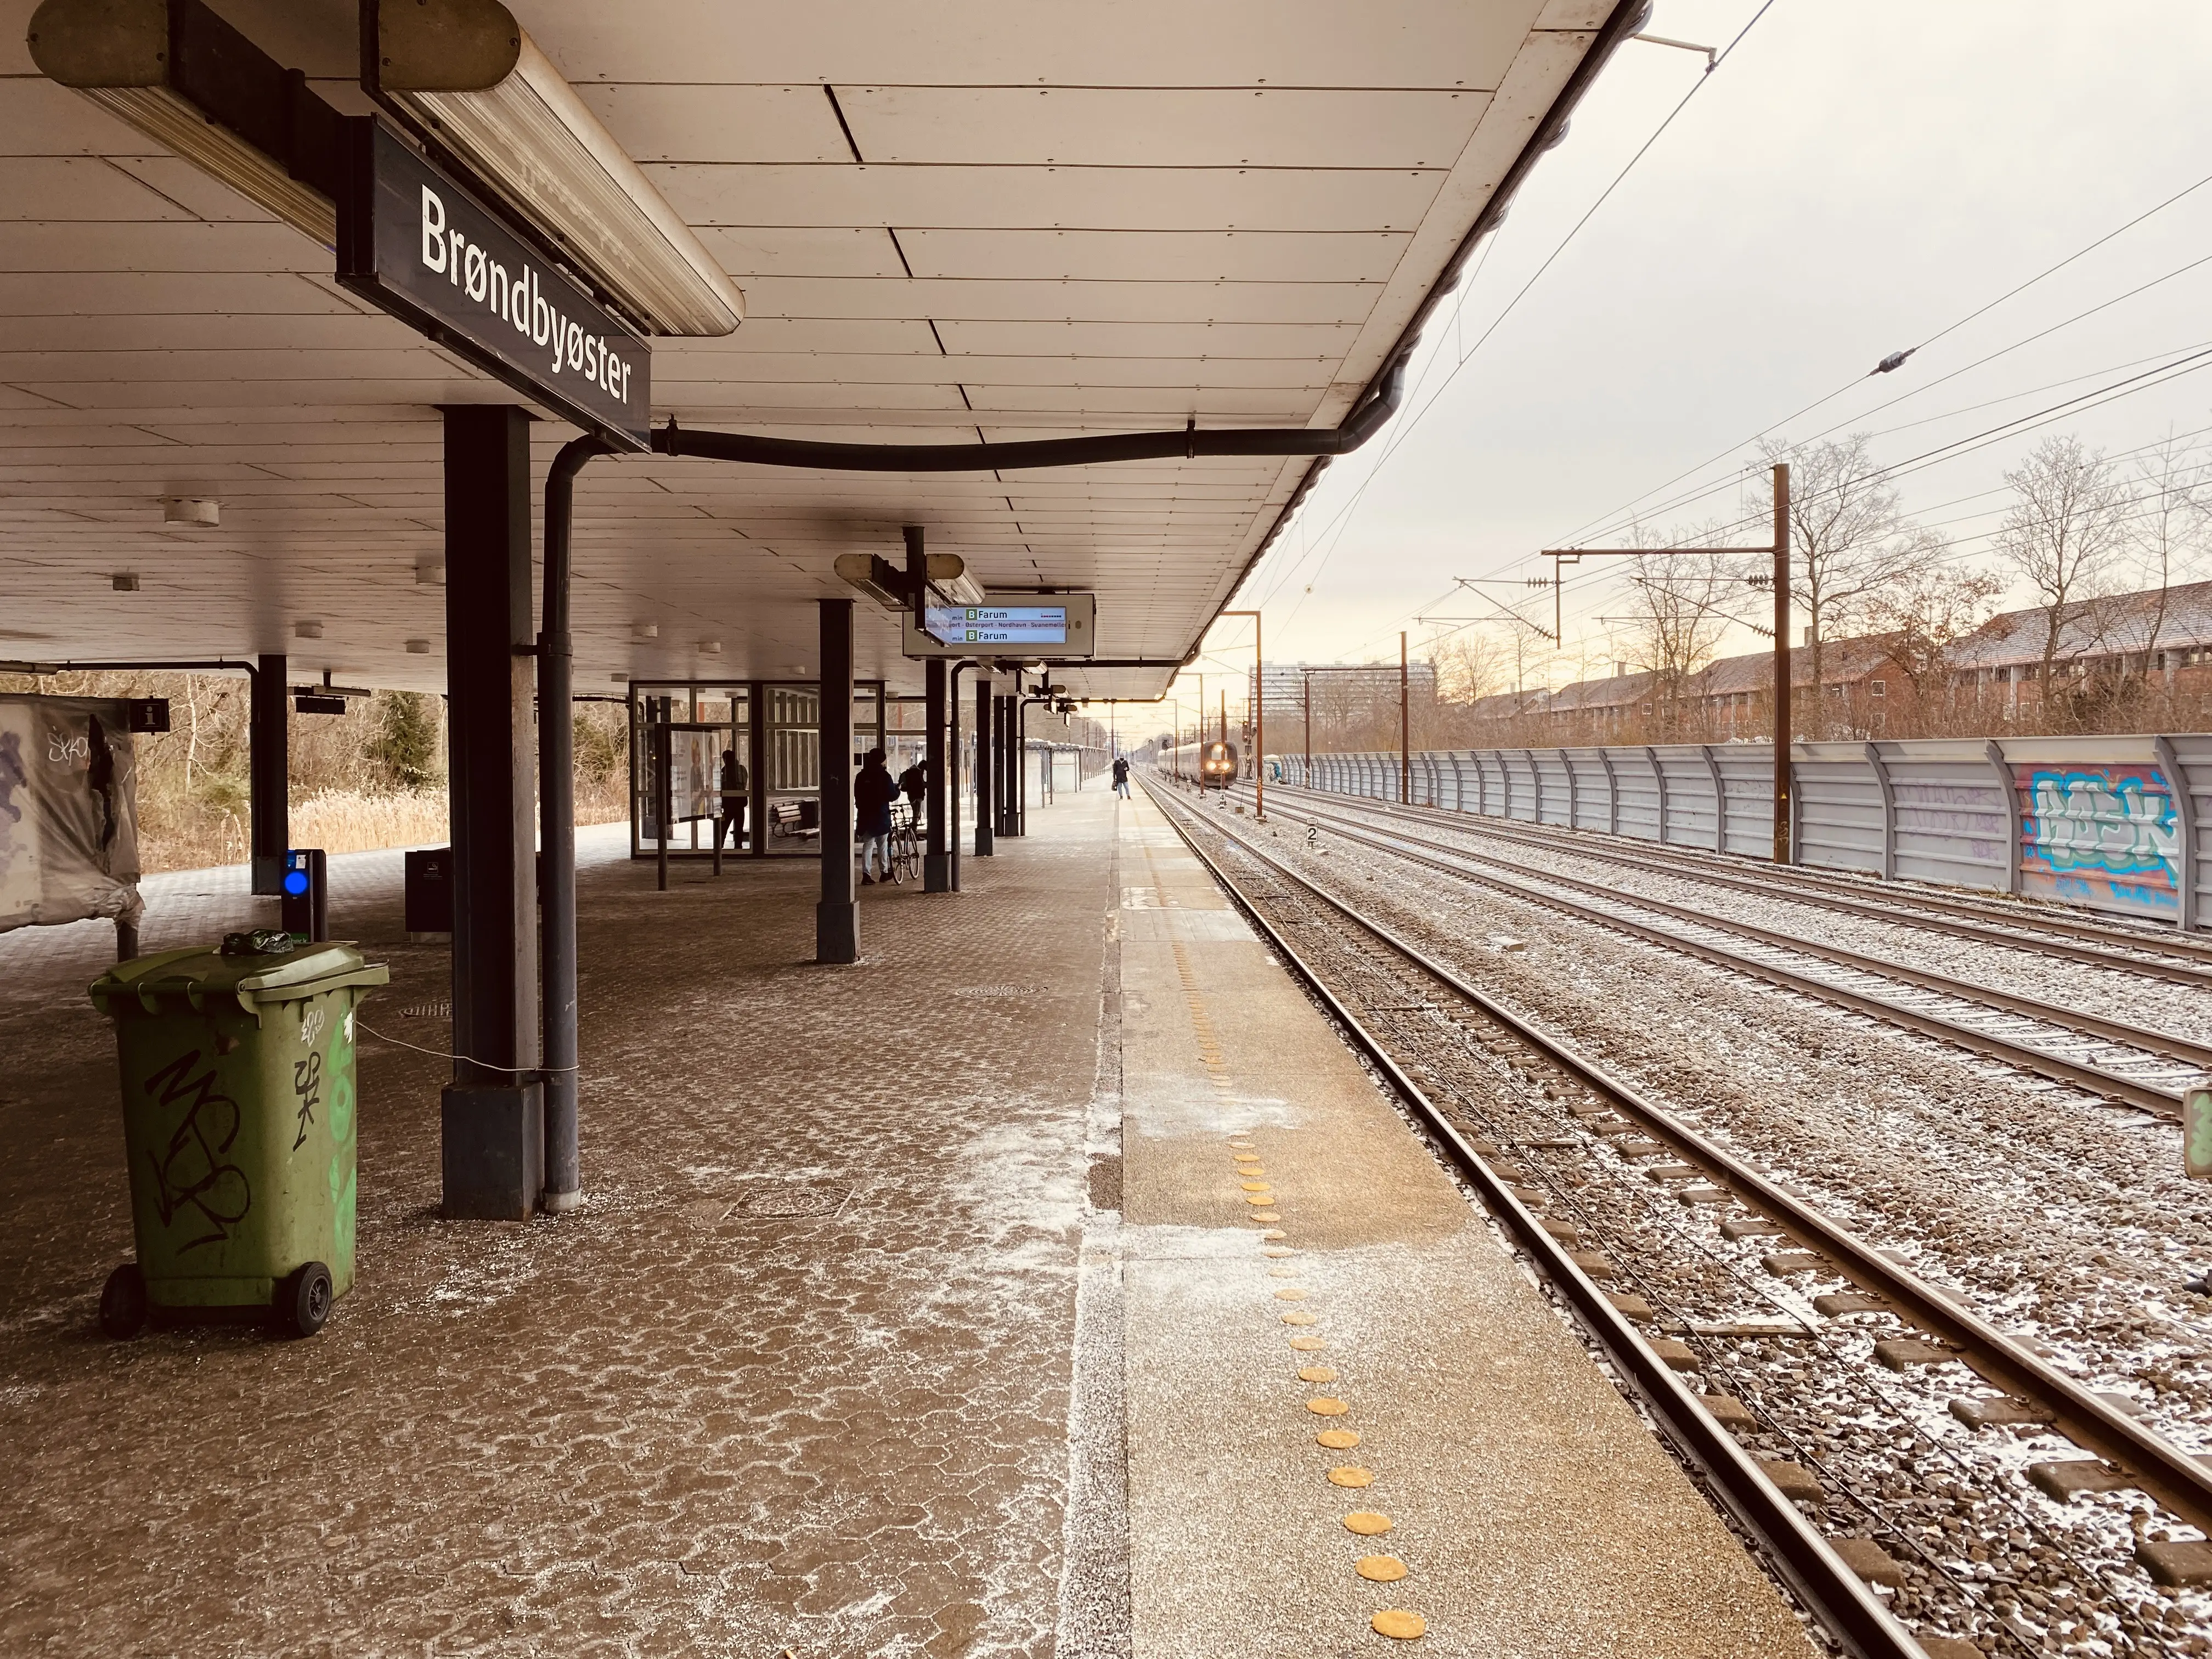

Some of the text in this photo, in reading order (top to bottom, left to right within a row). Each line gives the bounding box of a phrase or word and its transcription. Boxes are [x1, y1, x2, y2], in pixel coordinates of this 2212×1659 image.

[421, 184, 631, 405] Brøndbyøster
[969, 631, 975, 640] B
[1308, 828, 1317, 840] 2
